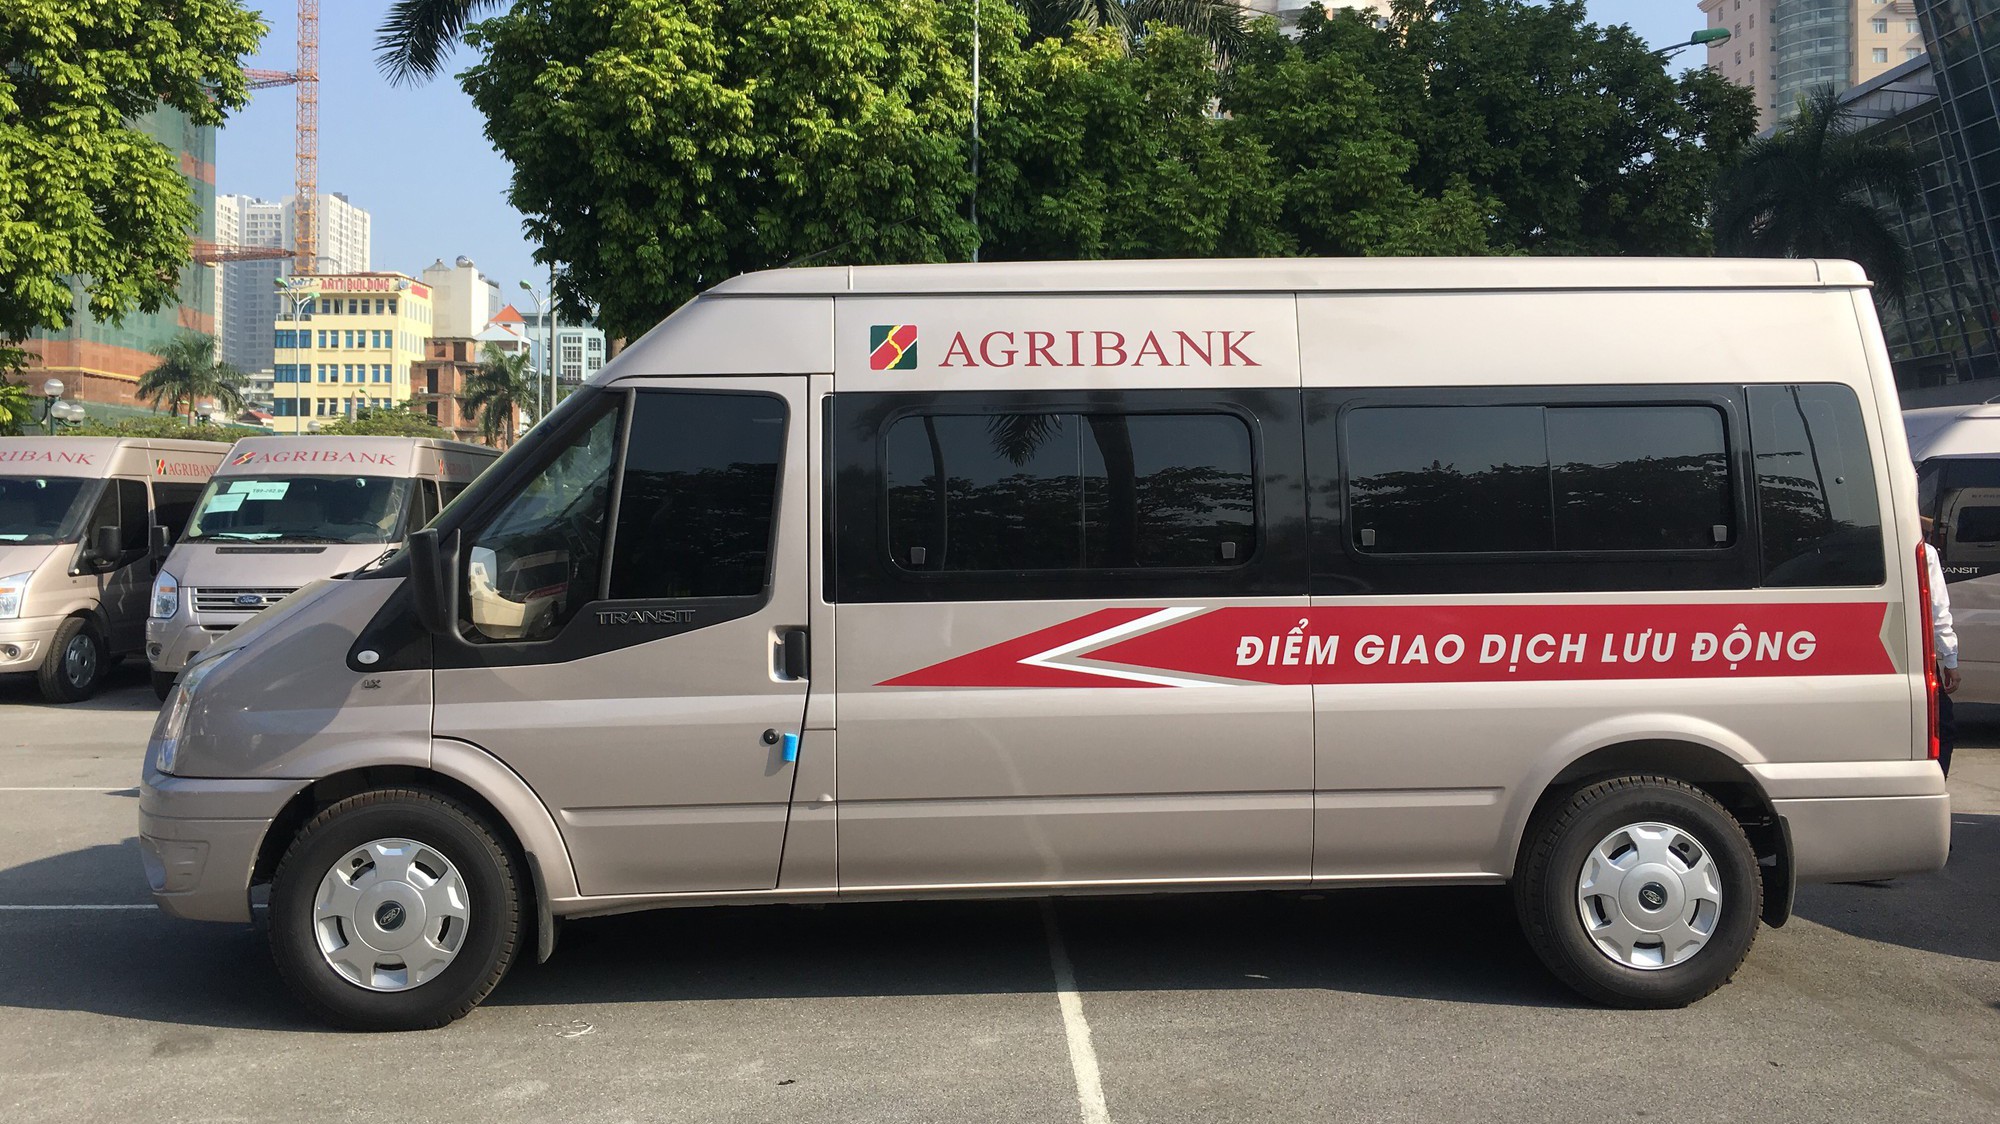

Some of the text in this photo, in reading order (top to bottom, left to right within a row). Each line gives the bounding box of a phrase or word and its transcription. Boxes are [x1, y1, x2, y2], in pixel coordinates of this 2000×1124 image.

[347, 278, 390, 291] BUILDING
[938, 330, 1262, 368] AGRIBANK
[255, 451, 397, 466] AGRIBANK
[168, 462, 218, 477] AGRIBAN
[1942, 566, 1980, 574] ANSIT
[596, 609, 696, 625] TRANSIT
[1236, 618, 1817, 672] ĐIỂM GIAO DỊCH LƯU ĐỘNG
